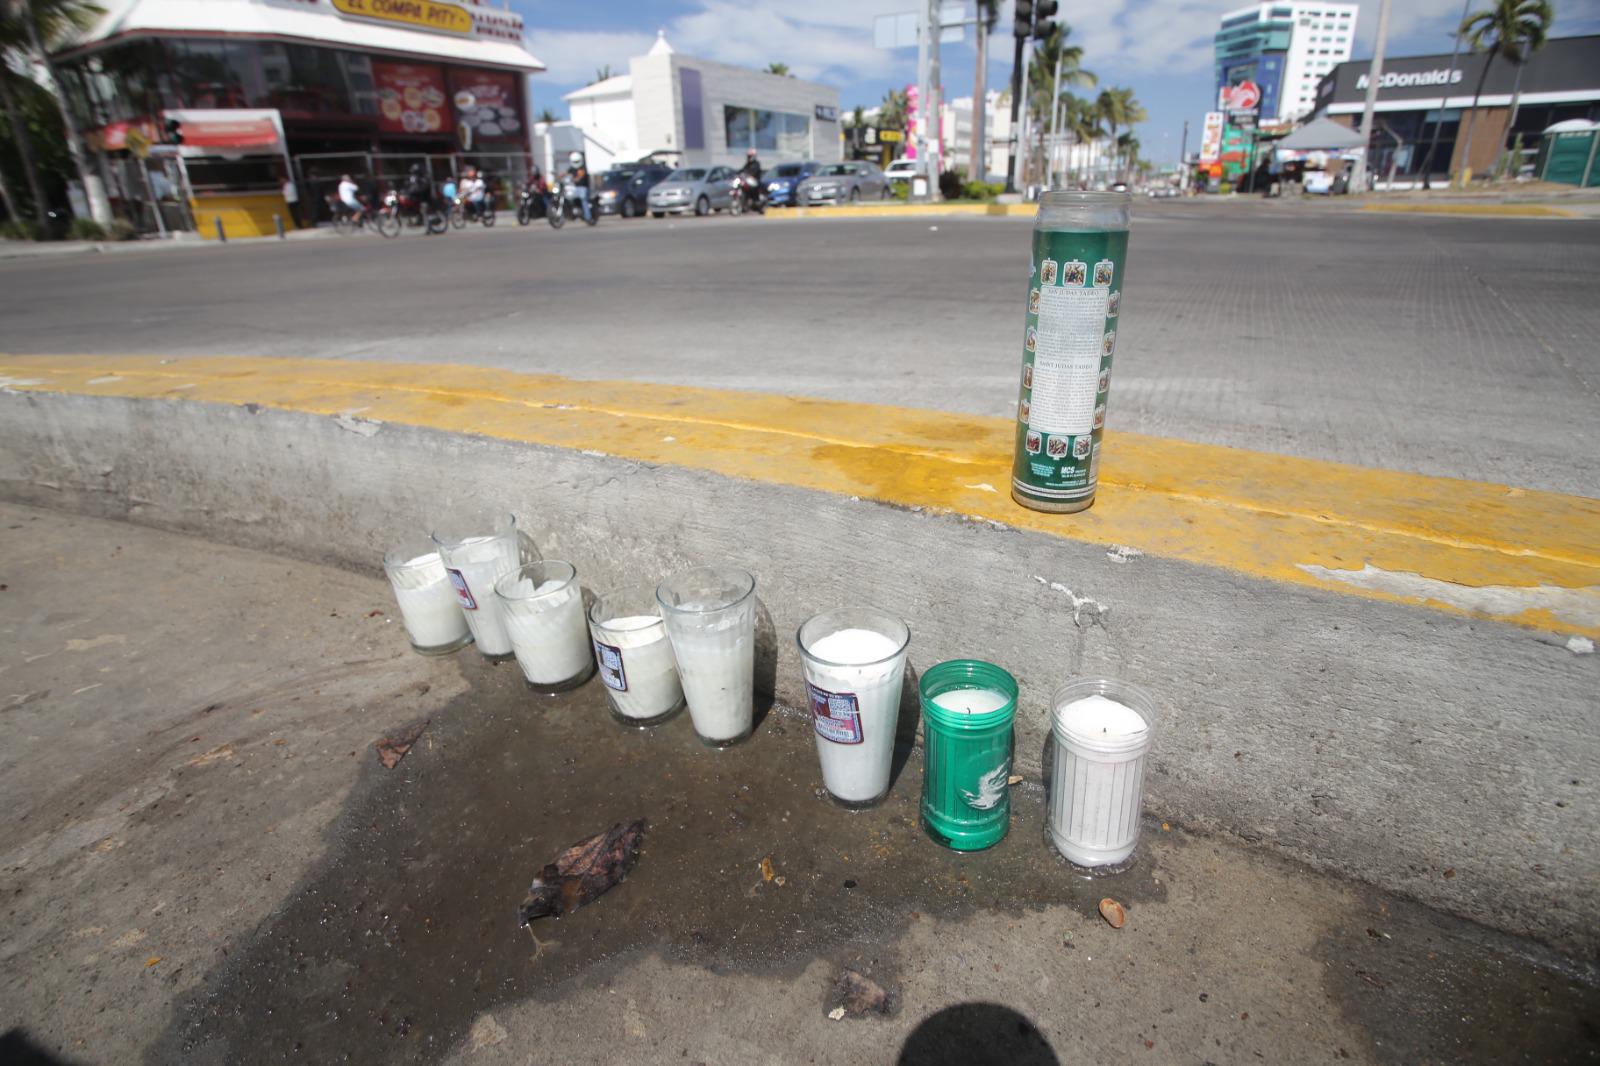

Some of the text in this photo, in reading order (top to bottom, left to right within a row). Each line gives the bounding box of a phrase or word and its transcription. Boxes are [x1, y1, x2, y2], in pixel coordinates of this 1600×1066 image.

[371, 0, 422, 17] COMPA
[427, 6, 456, 25] PITY
[1061, 466, 1075, 474] MCS
